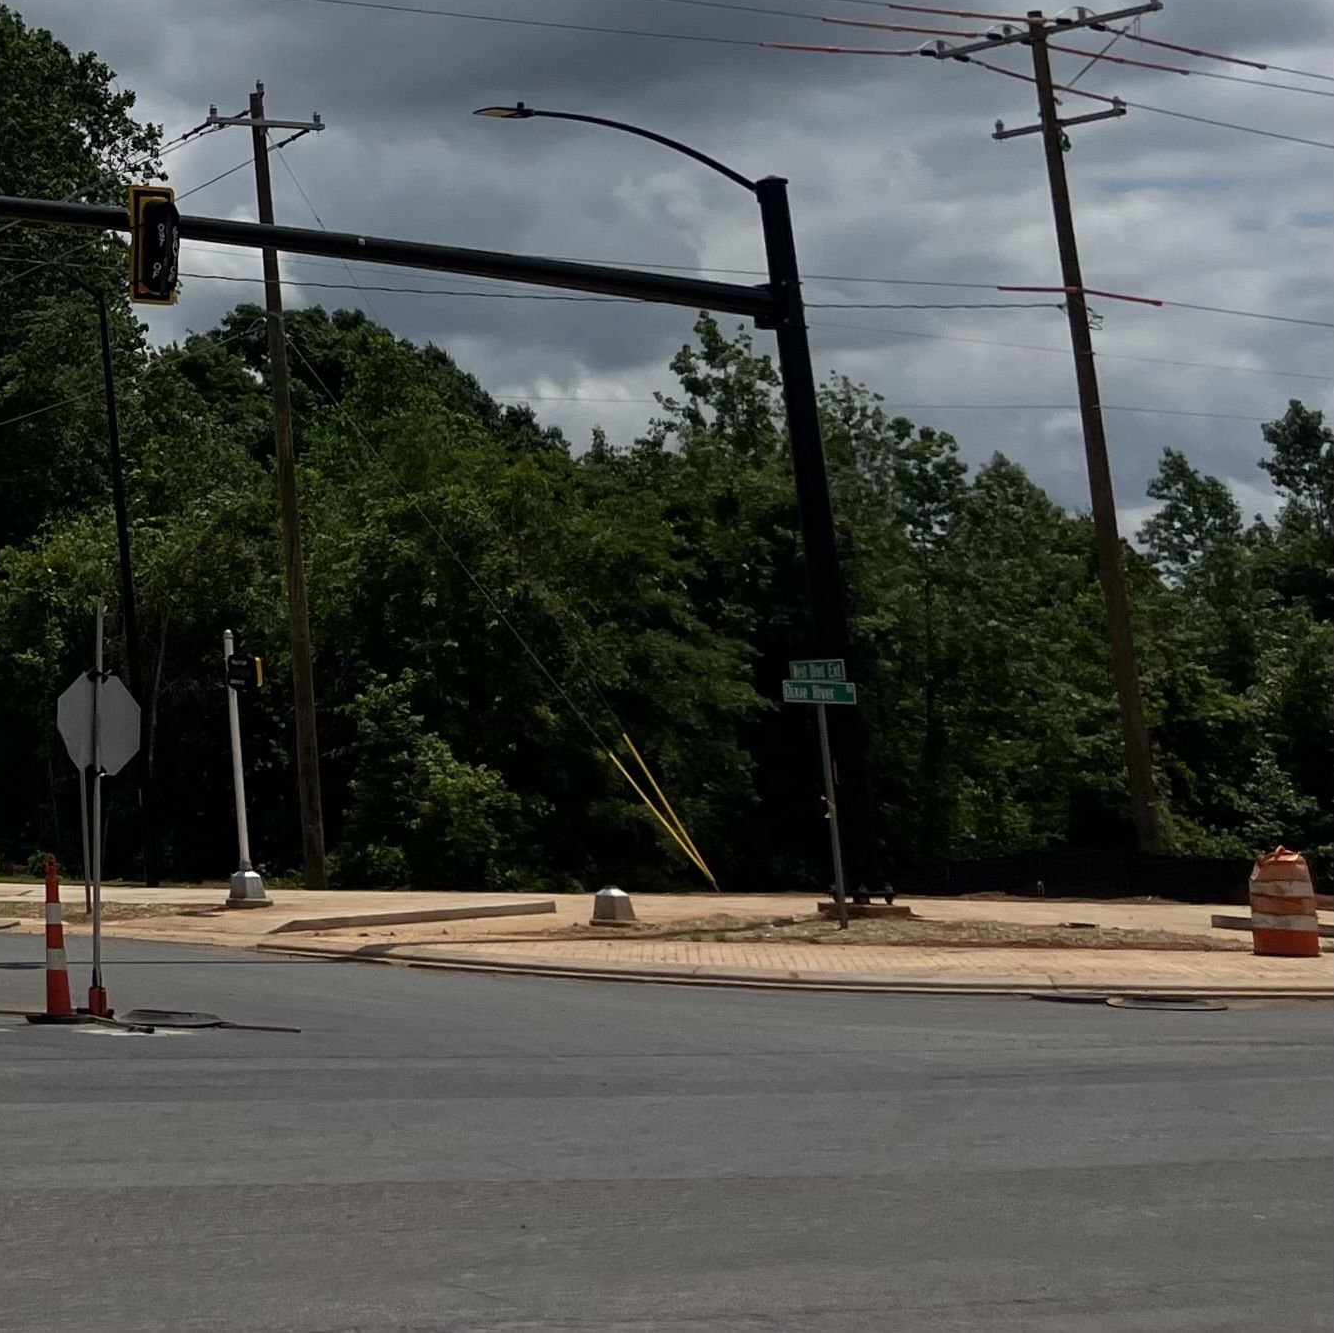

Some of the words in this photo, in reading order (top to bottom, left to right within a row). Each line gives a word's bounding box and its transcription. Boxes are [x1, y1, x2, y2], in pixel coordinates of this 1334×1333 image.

[157, 222, 165, 247] OUT
[152, 261, 162, 279] OF
[783, 682, 808, 699] Dixie
[812, 684, 835, 700] River
